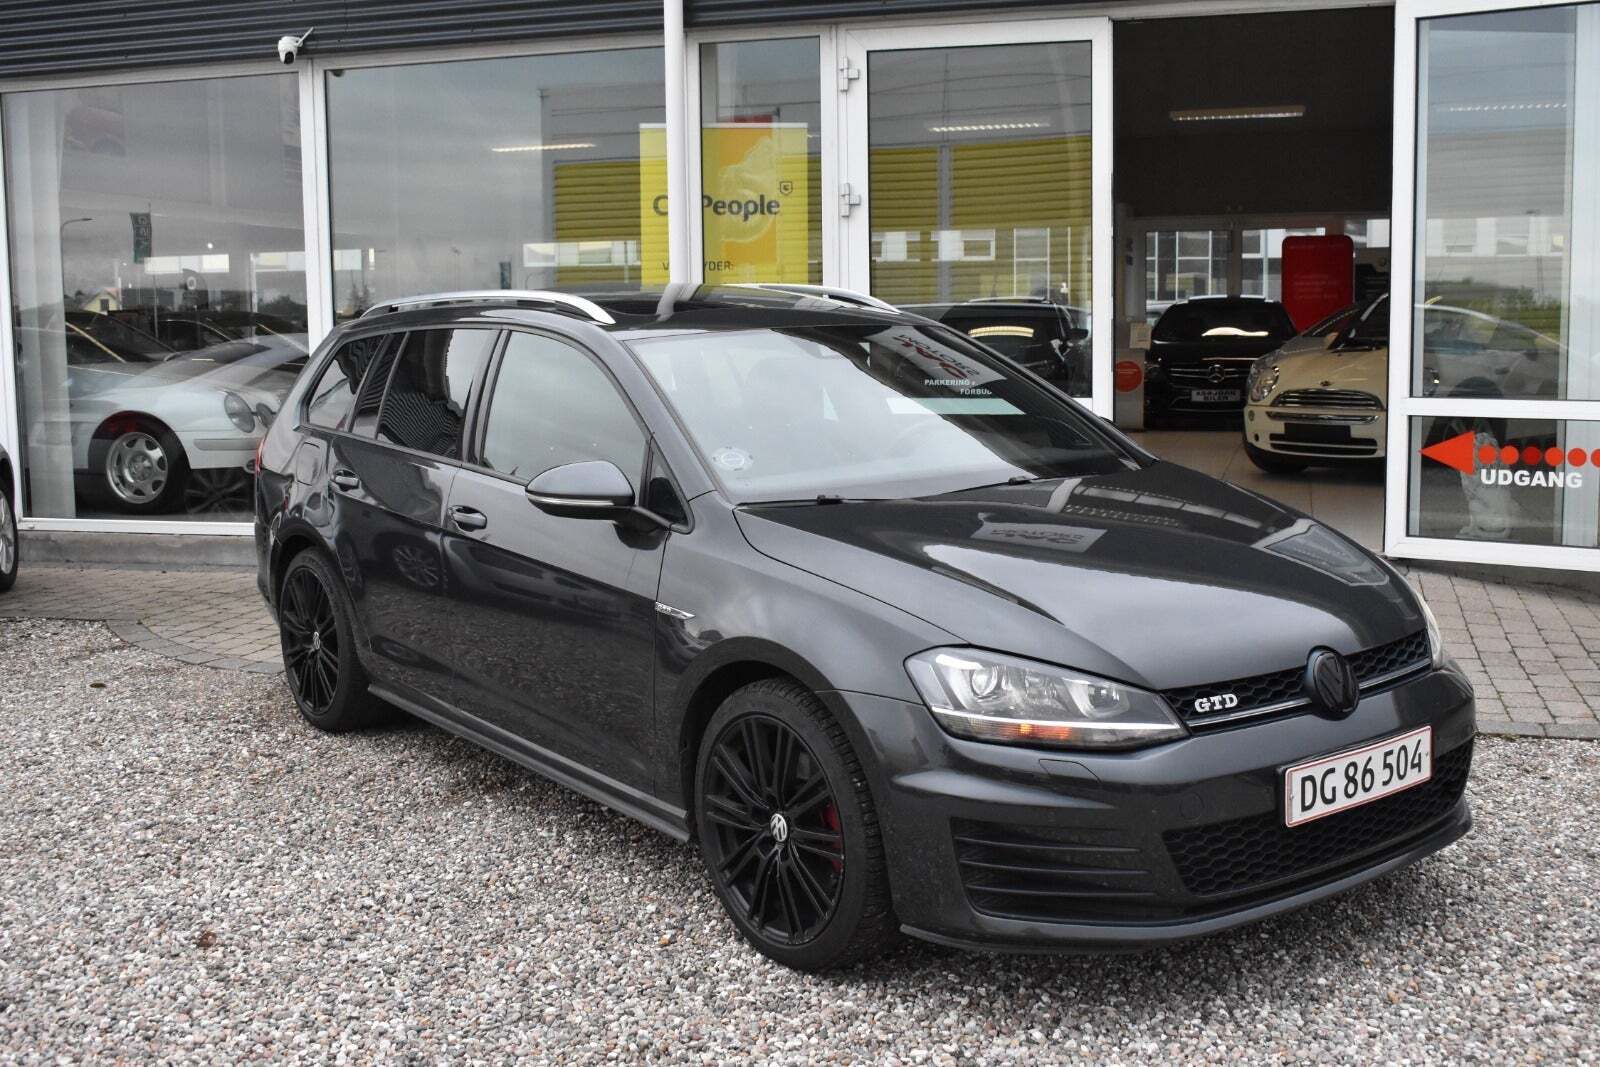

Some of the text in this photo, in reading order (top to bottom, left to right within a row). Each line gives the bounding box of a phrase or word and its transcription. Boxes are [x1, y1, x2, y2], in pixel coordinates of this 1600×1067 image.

[1480, 468, 1583, 488] UDGANG
[1194, 693, 1238, 713] GTD
[1300, 738, 1422, 813] DG 86 504
